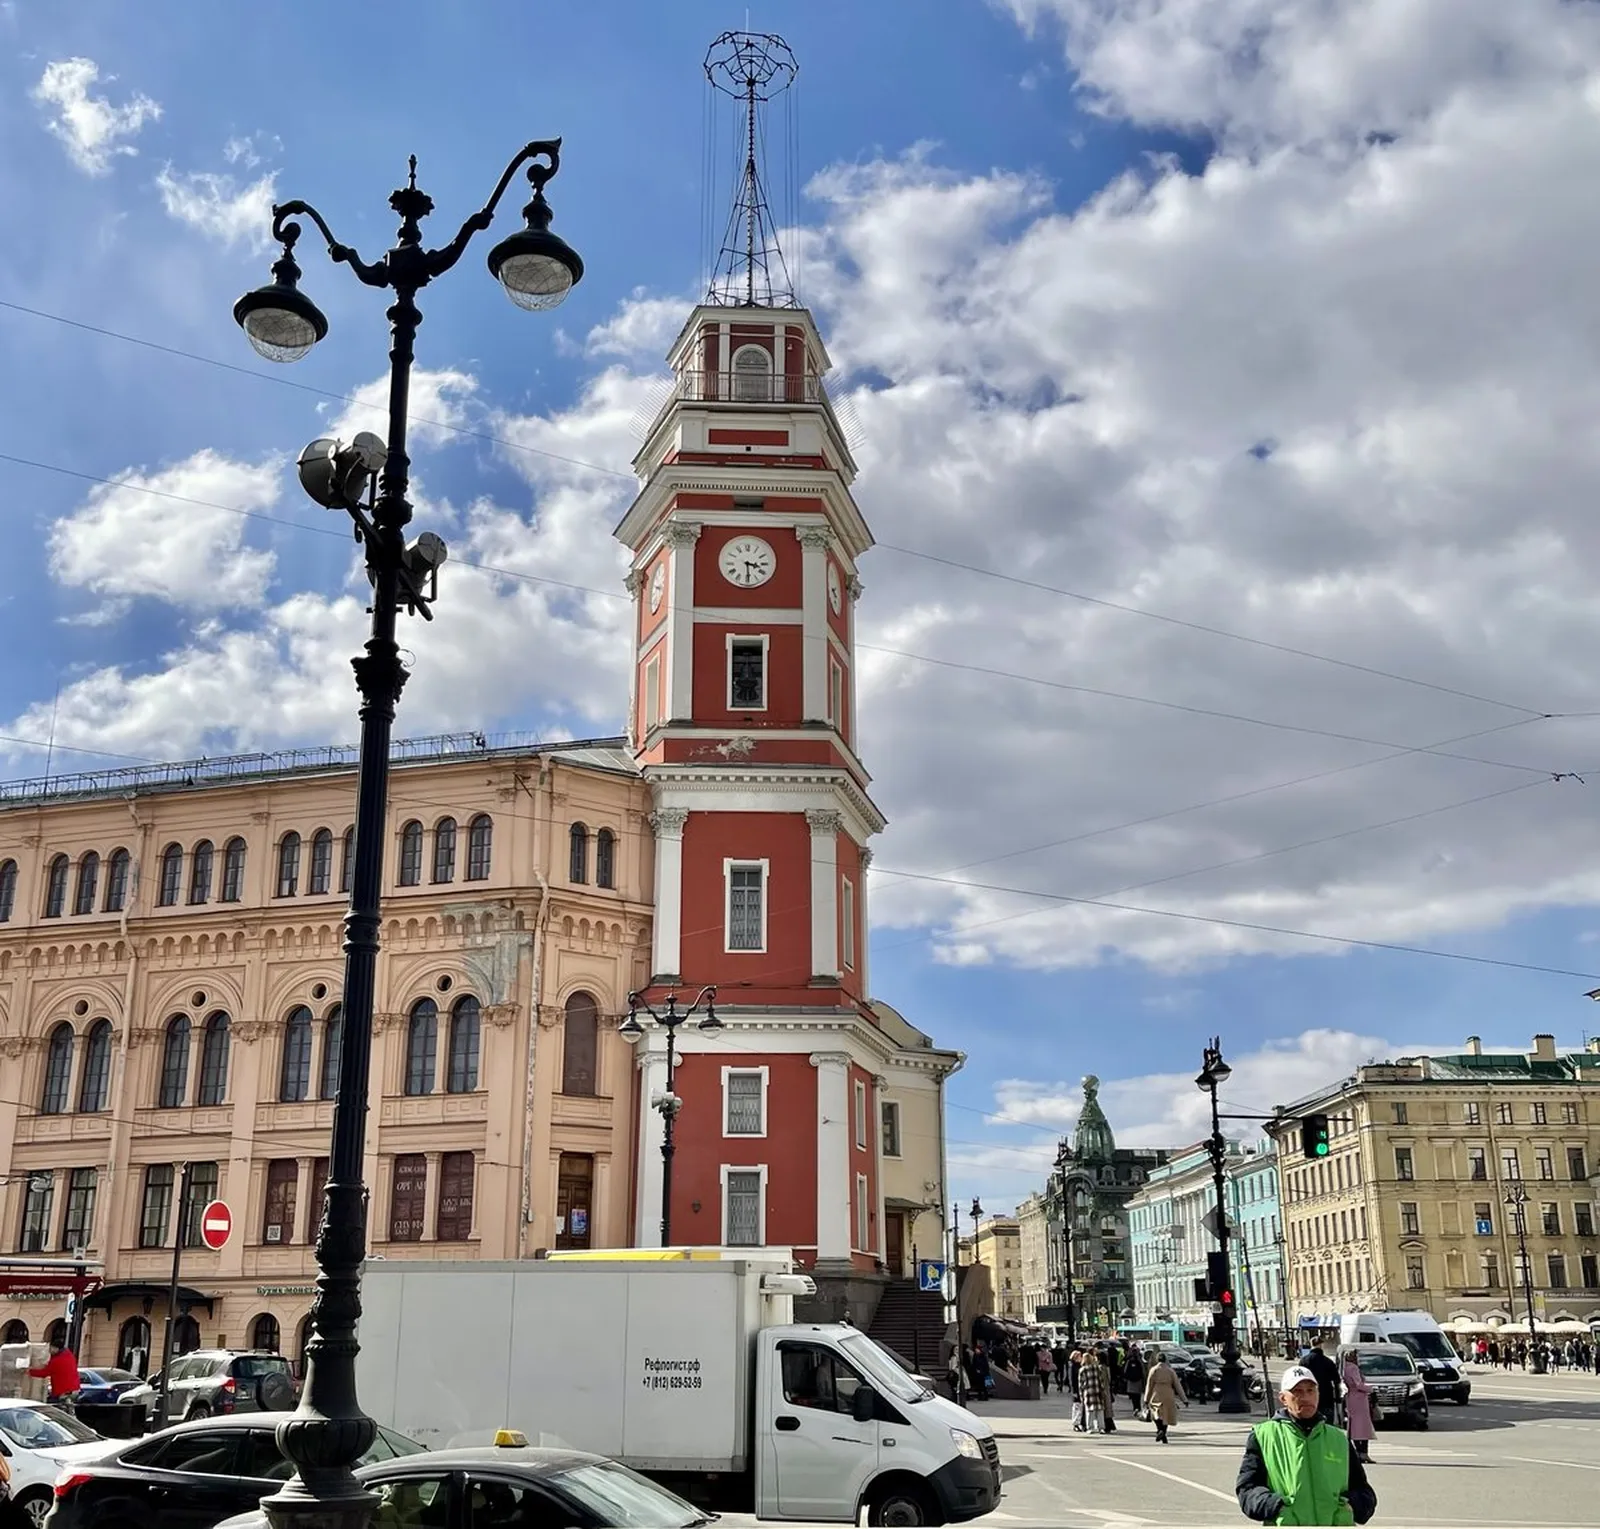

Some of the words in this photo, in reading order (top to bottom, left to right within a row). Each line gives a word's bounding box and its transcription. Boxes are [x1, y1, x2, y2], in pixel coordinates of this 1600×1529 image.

[642, 1376, 650, 1389] +7
[651, 1376, 669, 1391] (812)
[670, 1376, 702, 1389] 629-52-59
